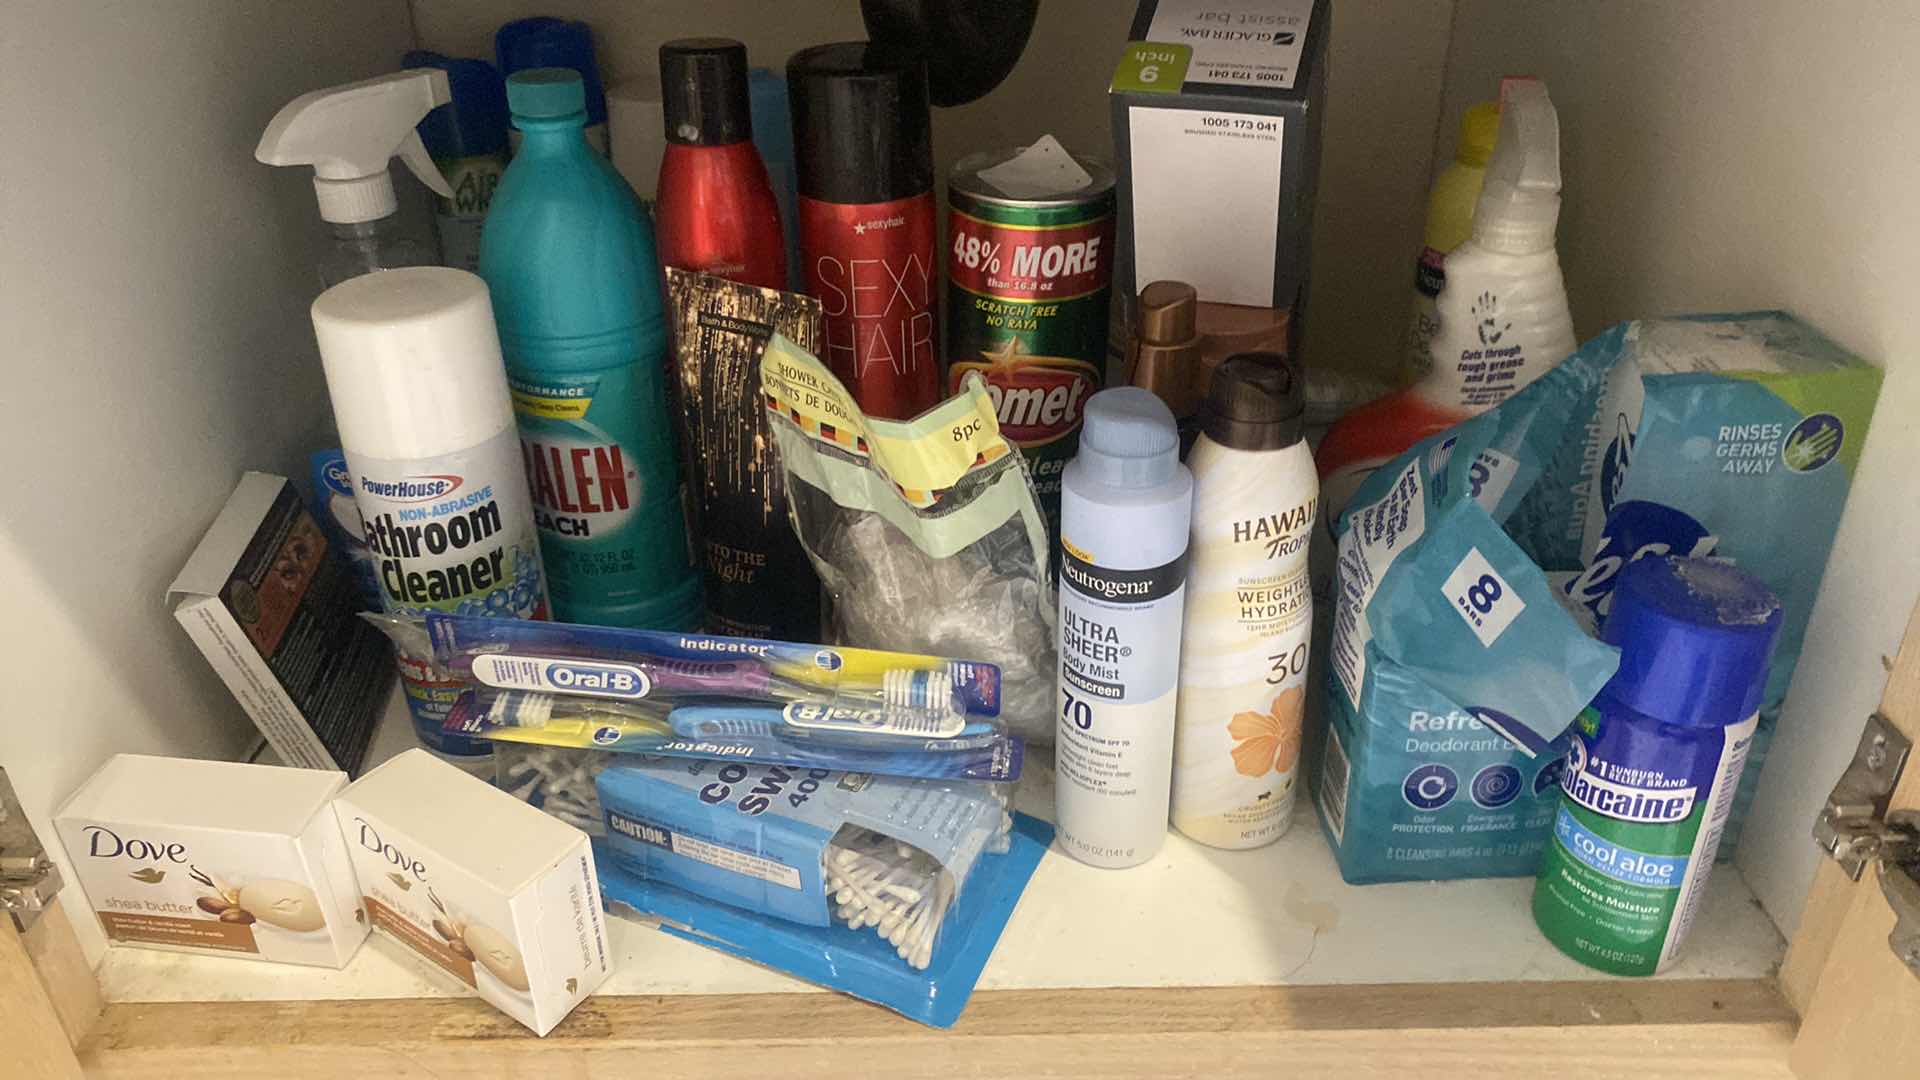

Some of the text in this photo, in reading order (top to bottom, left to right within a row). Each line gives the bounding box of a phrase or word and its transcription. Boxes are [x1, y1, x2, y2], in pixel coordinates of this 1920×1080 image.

[1195, 11, 1232, 24] bar
[1215, 29, 1272, 42] GLACIER
[1134, 51, 1176, 64] inch
[1256, 71, 1286, 82] 1005
[1202, 117, 1277, 132] 1005 173 041
[866, 215, 905, 232] sexyhair
[953, 231, 1101, 279] 48% MORE
[817, 246, 934, 319] SEXY
[986, 277, 1010, 290] than
[974, 298, 1058, 317] SCRATCH FREE
[985, 314, 1039, 330] NO RAYA
[826, 312, 934, 379] HAIR
[1461, 345, 1523, 361] Cuts through
[1457, 358, 1525, 374] tough grease
[1464, 373, 1485, 383] and
[805, 394, 820, 410] DE
[985, 375, 1087, 427] omet
[952, 416, 984, 442] 8pc
[1717, 422, 1784, 442] RINSES
[1714, 440, 1779, 458] GERMS
[524, 443, 631, 513] ALEN
[1721, 457, 1776, 475] AWAY
[360, 476, 444, 498] PowerHouse
[398, 485, 493, 522] NON-ABRASIVE
[365, 500, 503, 558] athroom
[535, 508, 590, 537] EACH
[381, 545, 503, 604] Cleaner
[1063, 555, 1153, 598] Neutrogena
[1467, 573, 1503, 615] 8
[1457, 596, 1483, 627] BARS
[1064, 605, 1120, 644] ULTRA
[680, 637, 768, 656] Indicator
[1063, 646, 1120, 681] Body Mist
[1266, 642, 1307, 685] 30
[553, 667, 636, 691] Oral-B
[1064, 667, 1121, 698] Sunscreen
[797, 703, 882, 725] Oral-B
[1062, 687, 1092, 731] 70
[1408, 710, 1484, 733] Refre
[1405, 736, 1500, 754] Deodorant
[1590, 756, 1665, 780] #1 SUNBURN
[1608, 770, 1688, 788] RELIEF BRAND
[1561, 769, 1687, 820] olarcaine
[610, 813, 668, 847] CAUTION:
[1392, 823, 1455, 834] PROTECTION
[82, 825, 188, 865] Dove
[353, 816, 428, 883] Dove
[1573, 831, 1616, 866] cool
[1619, 853, 1675, 878] aloe
[1560, 868, 1605, 903] Restores
[1606, 895, 1661, 914] Moisture
[105, 896, 194, 915] shea butter
